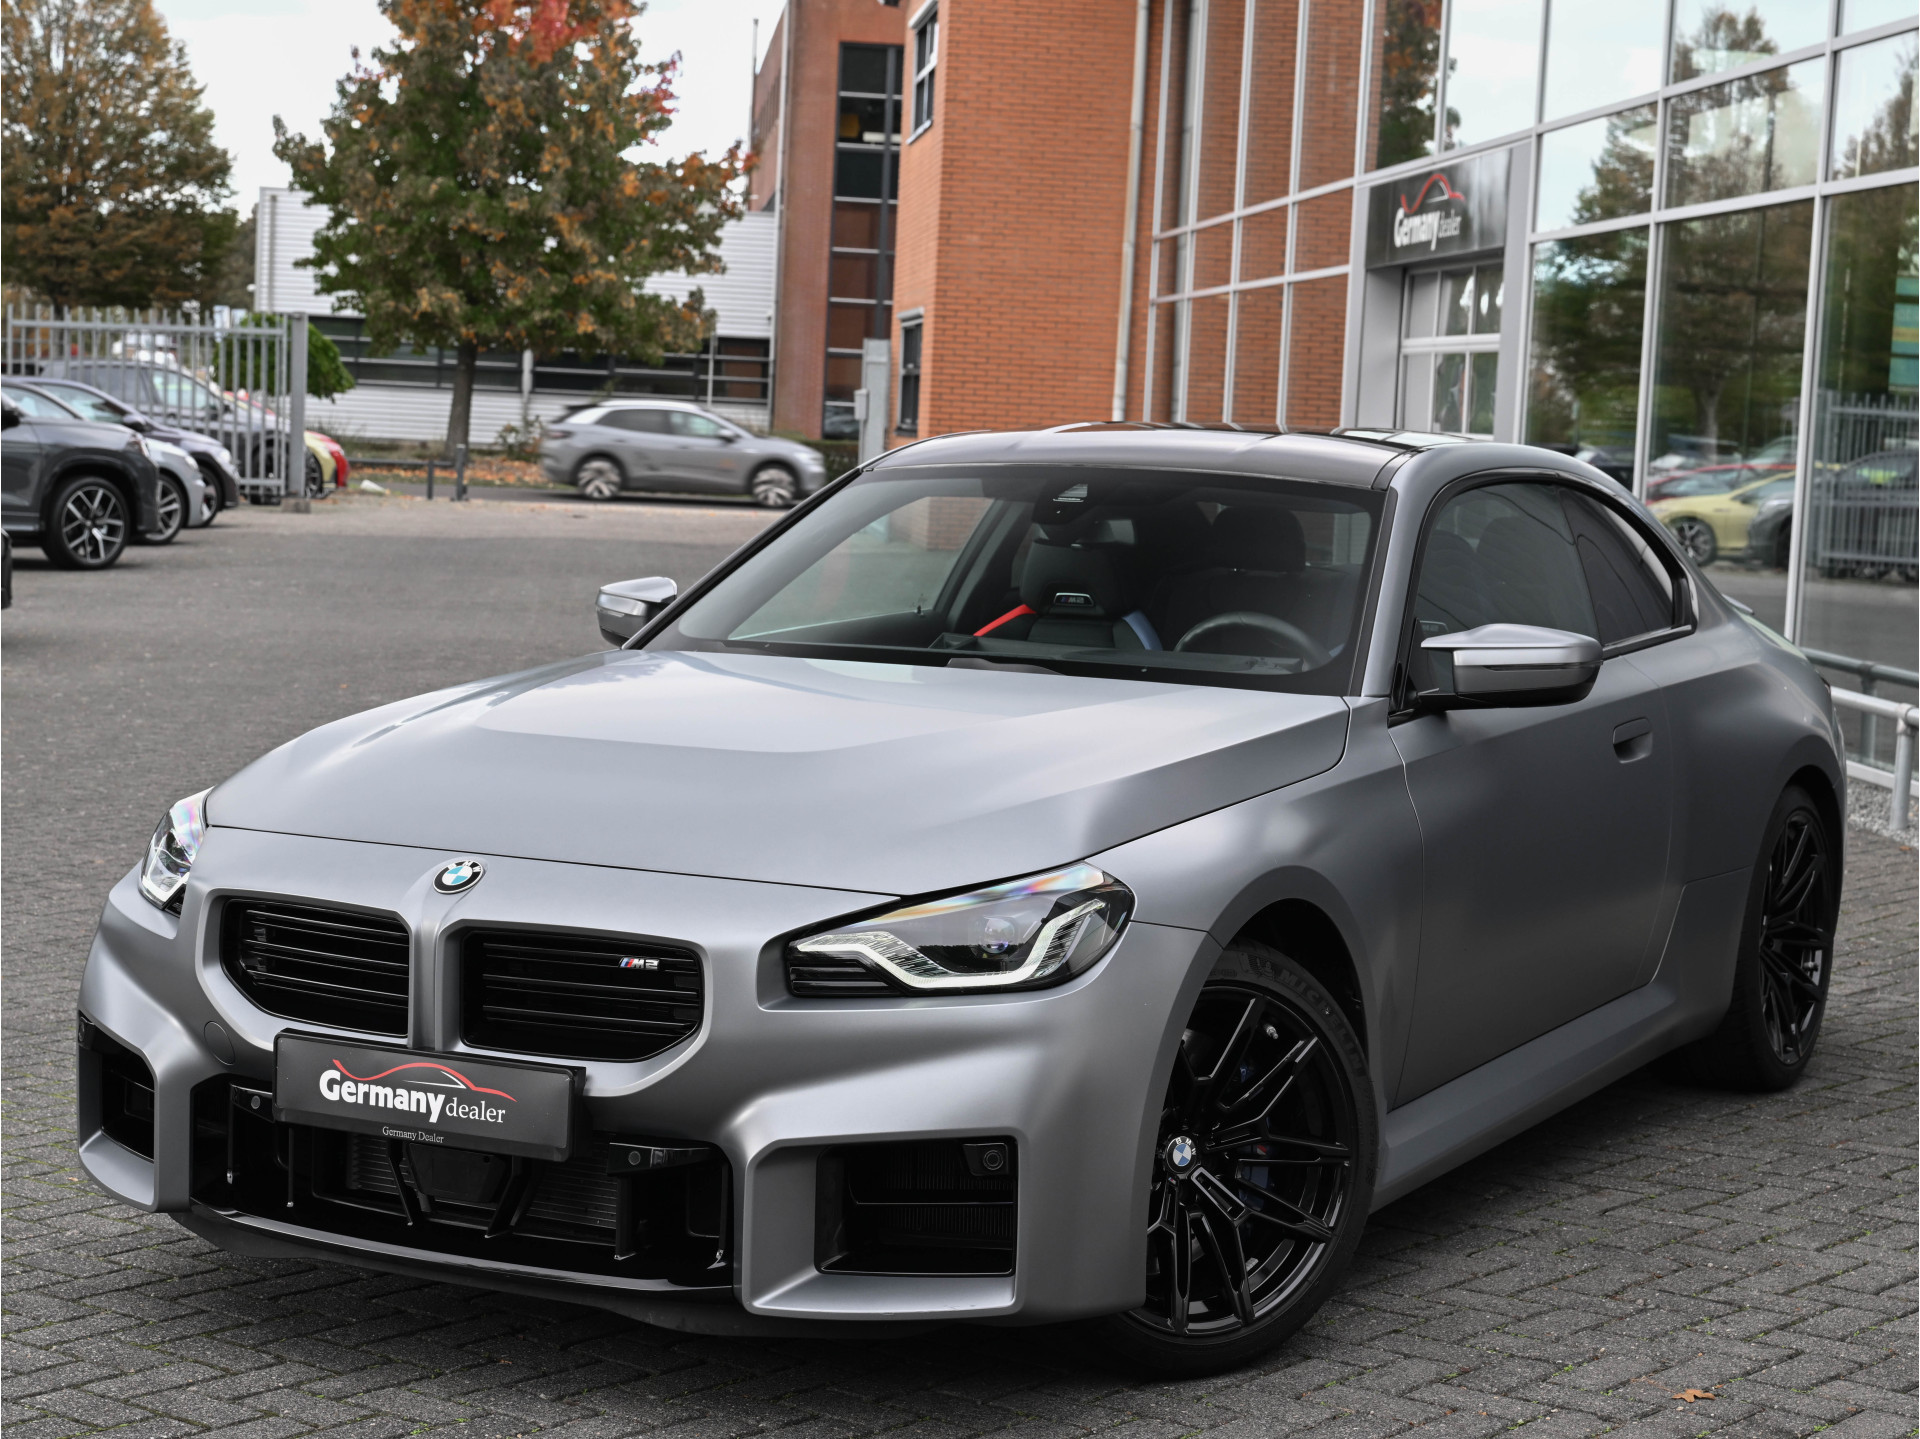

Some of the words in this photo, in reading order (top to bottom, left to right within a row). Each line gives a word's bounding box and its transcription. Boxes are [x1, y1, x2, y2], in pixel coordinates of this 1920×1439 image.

[1394, 207, 1440, 251] Germany
[319, 1069, 445, 1123] Germany
[445, 1097, 506, 1124] dealer
[382, 1126, 417, 1141] Germany
[418, 1131, 444, 1144] Dealer
